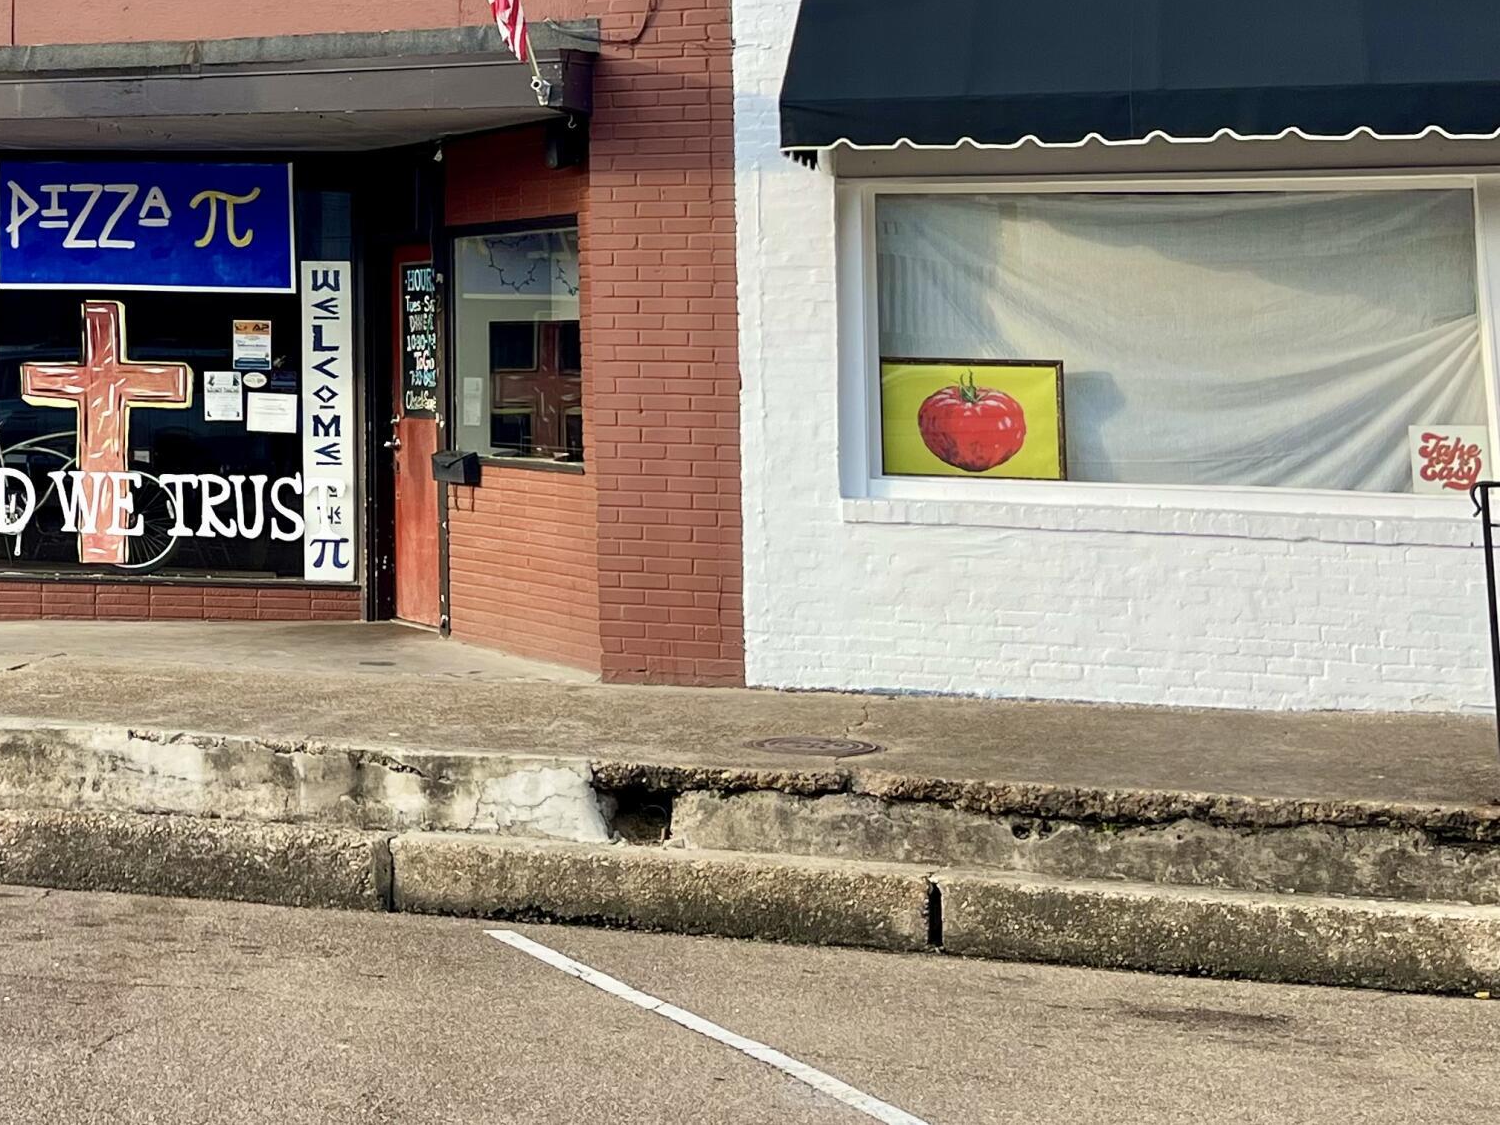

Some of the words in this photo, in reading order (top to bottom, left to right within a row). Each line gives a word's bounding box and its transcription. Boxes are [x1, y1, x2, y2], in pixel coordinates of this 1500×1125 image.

[5, 179, 172, 249] PIZZA
[1418, 432, 1482, 465] Take
[1420, 456, 1481, 491] Easy
[47, 470, 145, 537] WE
[159, 471, 347, 542] TRUST
